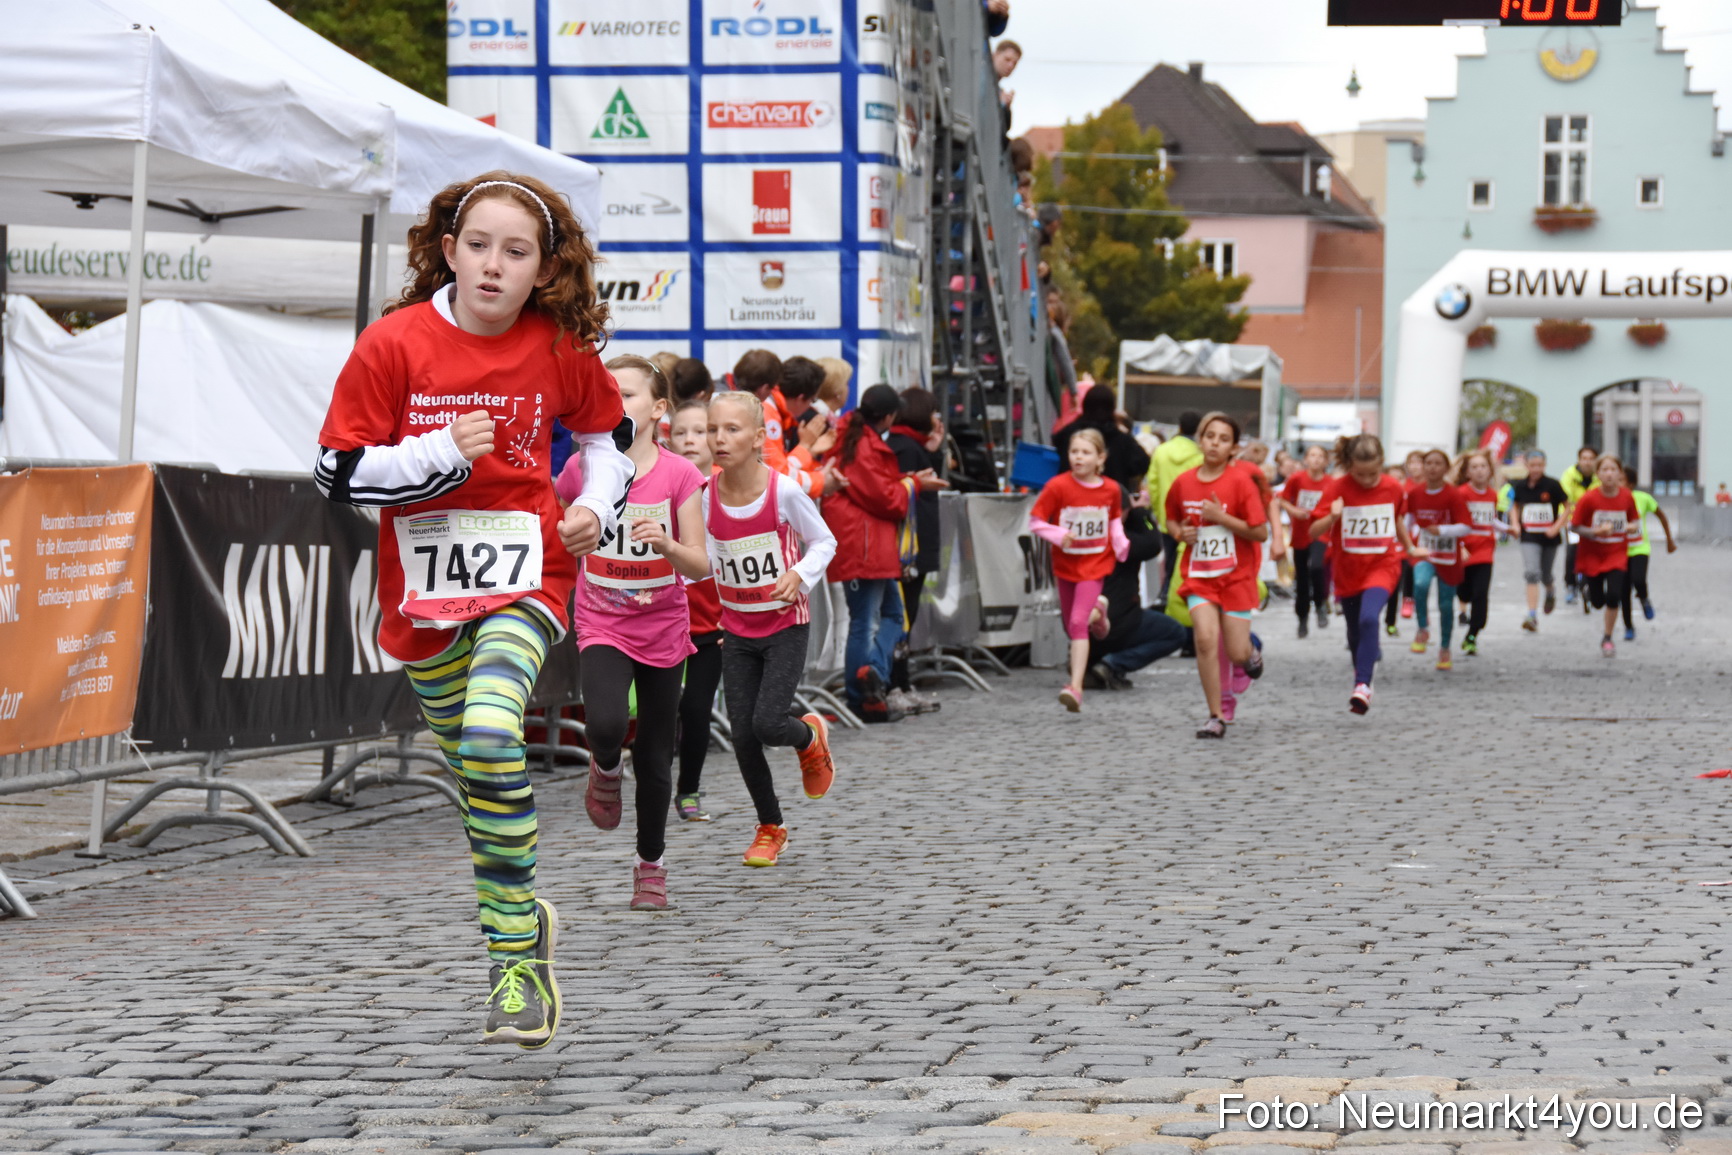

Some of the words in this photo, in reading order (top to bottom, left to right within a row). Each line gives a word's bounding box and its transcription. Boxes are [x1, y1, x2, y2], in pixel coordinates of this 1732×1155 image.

[590, 21, 681, 36] VARIOTEC
[711, 100, 801, 123] charivari
[1487, 267, 1588, 297] BMW
[1601, 267, 1732, 303] Laufsp
[729, 308, 816, 322] Lammsbräu
[410, 392, 508, 407] Neumarkter
[624, 504, 667, 517] BOCK
[409, 526, 450, 536] NeuerMarkt
[458, 514, 529, 531] BOCK
[1348, 516, 1390, 535] 7217
[730, 536, 772, 552] BOCK
[414, 542, 529, 592] 7427
[606, 562, 650, 579] Sophia
[717, 551, 779, 585] 7194
[222, 542, 331, 679] MINI
[97, 674, 114, 693] 897
